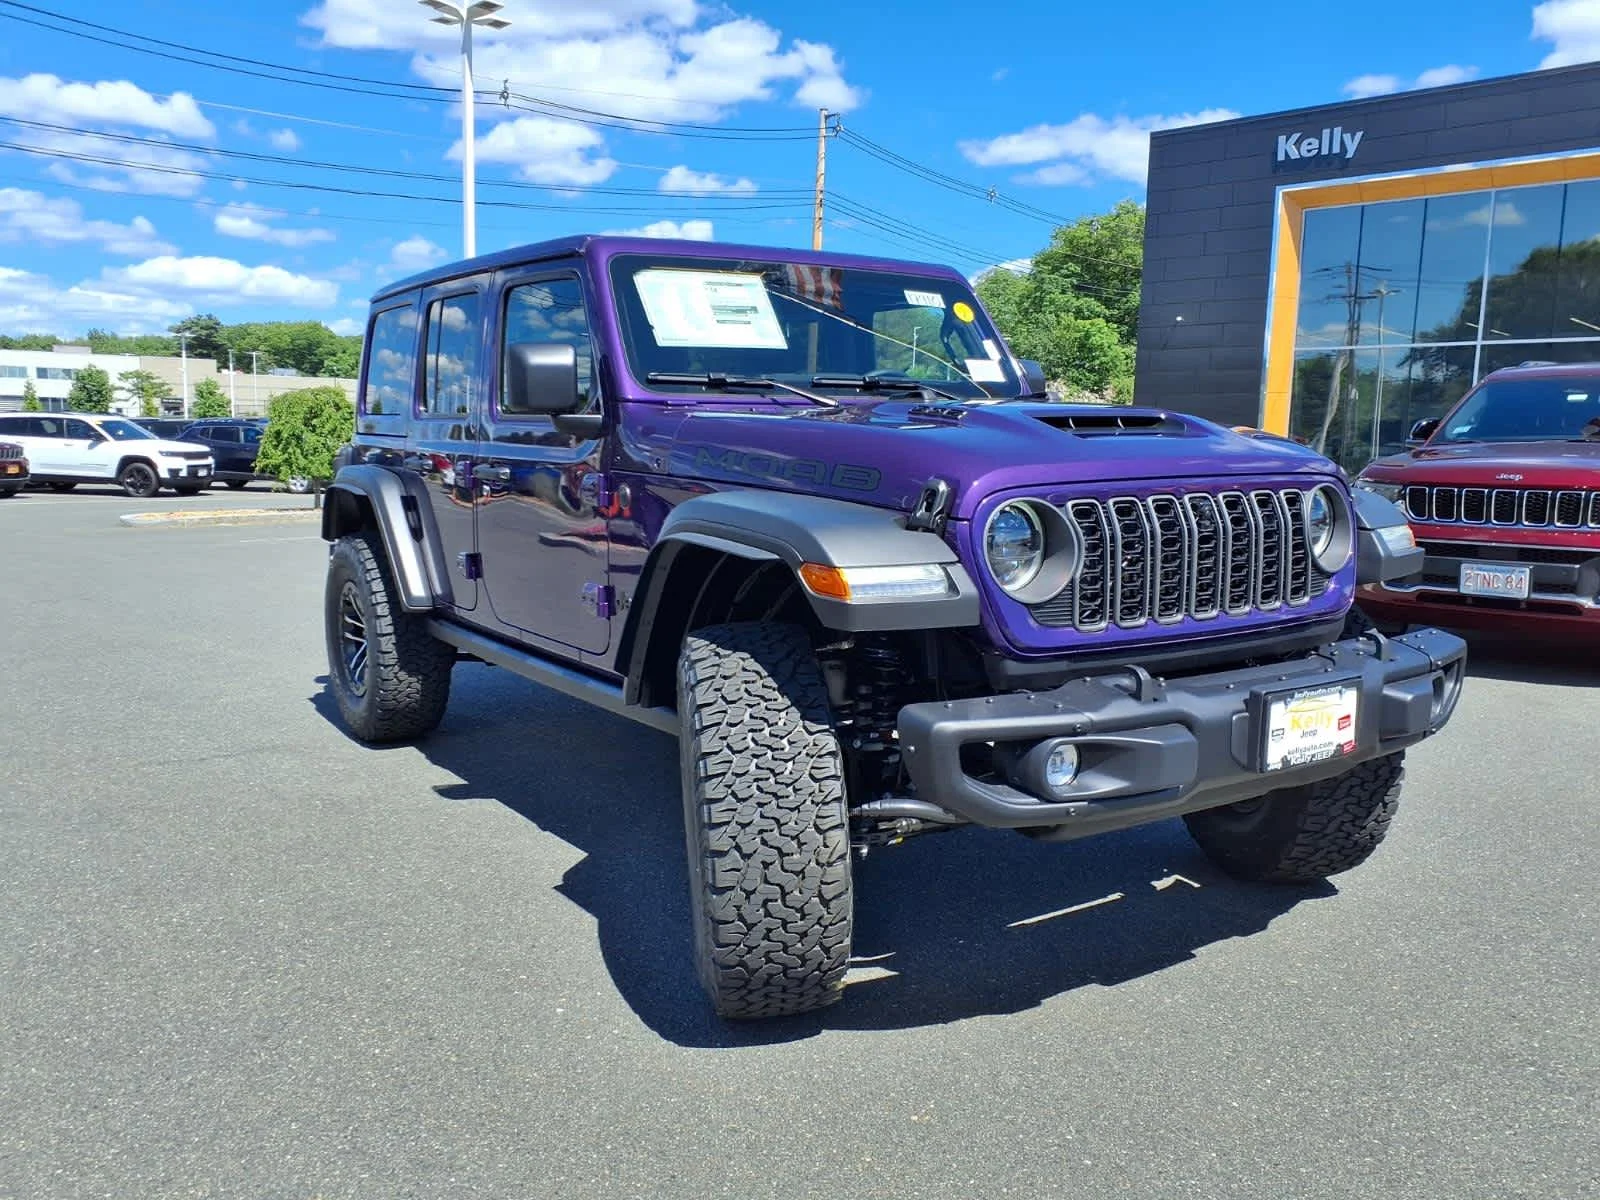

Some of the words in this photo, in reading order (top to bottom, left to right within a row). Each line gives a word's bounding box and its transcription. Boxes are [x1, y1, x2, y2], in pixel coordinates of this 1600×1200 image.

[1277, 126, 1364, 161] Kelly
[695, 447, 881, 492] MOAB
[1495, 472, 1523, 481] Jeep
[1463, 571, 1501, 589] 2TNC
[1504, 574, 1525, 590] 84
[1291, 711, 1333, 731] Kelly
[1300, 729, 1318, 739] Jeep
[1288, 741, 1334, 755] kellyauto.com
